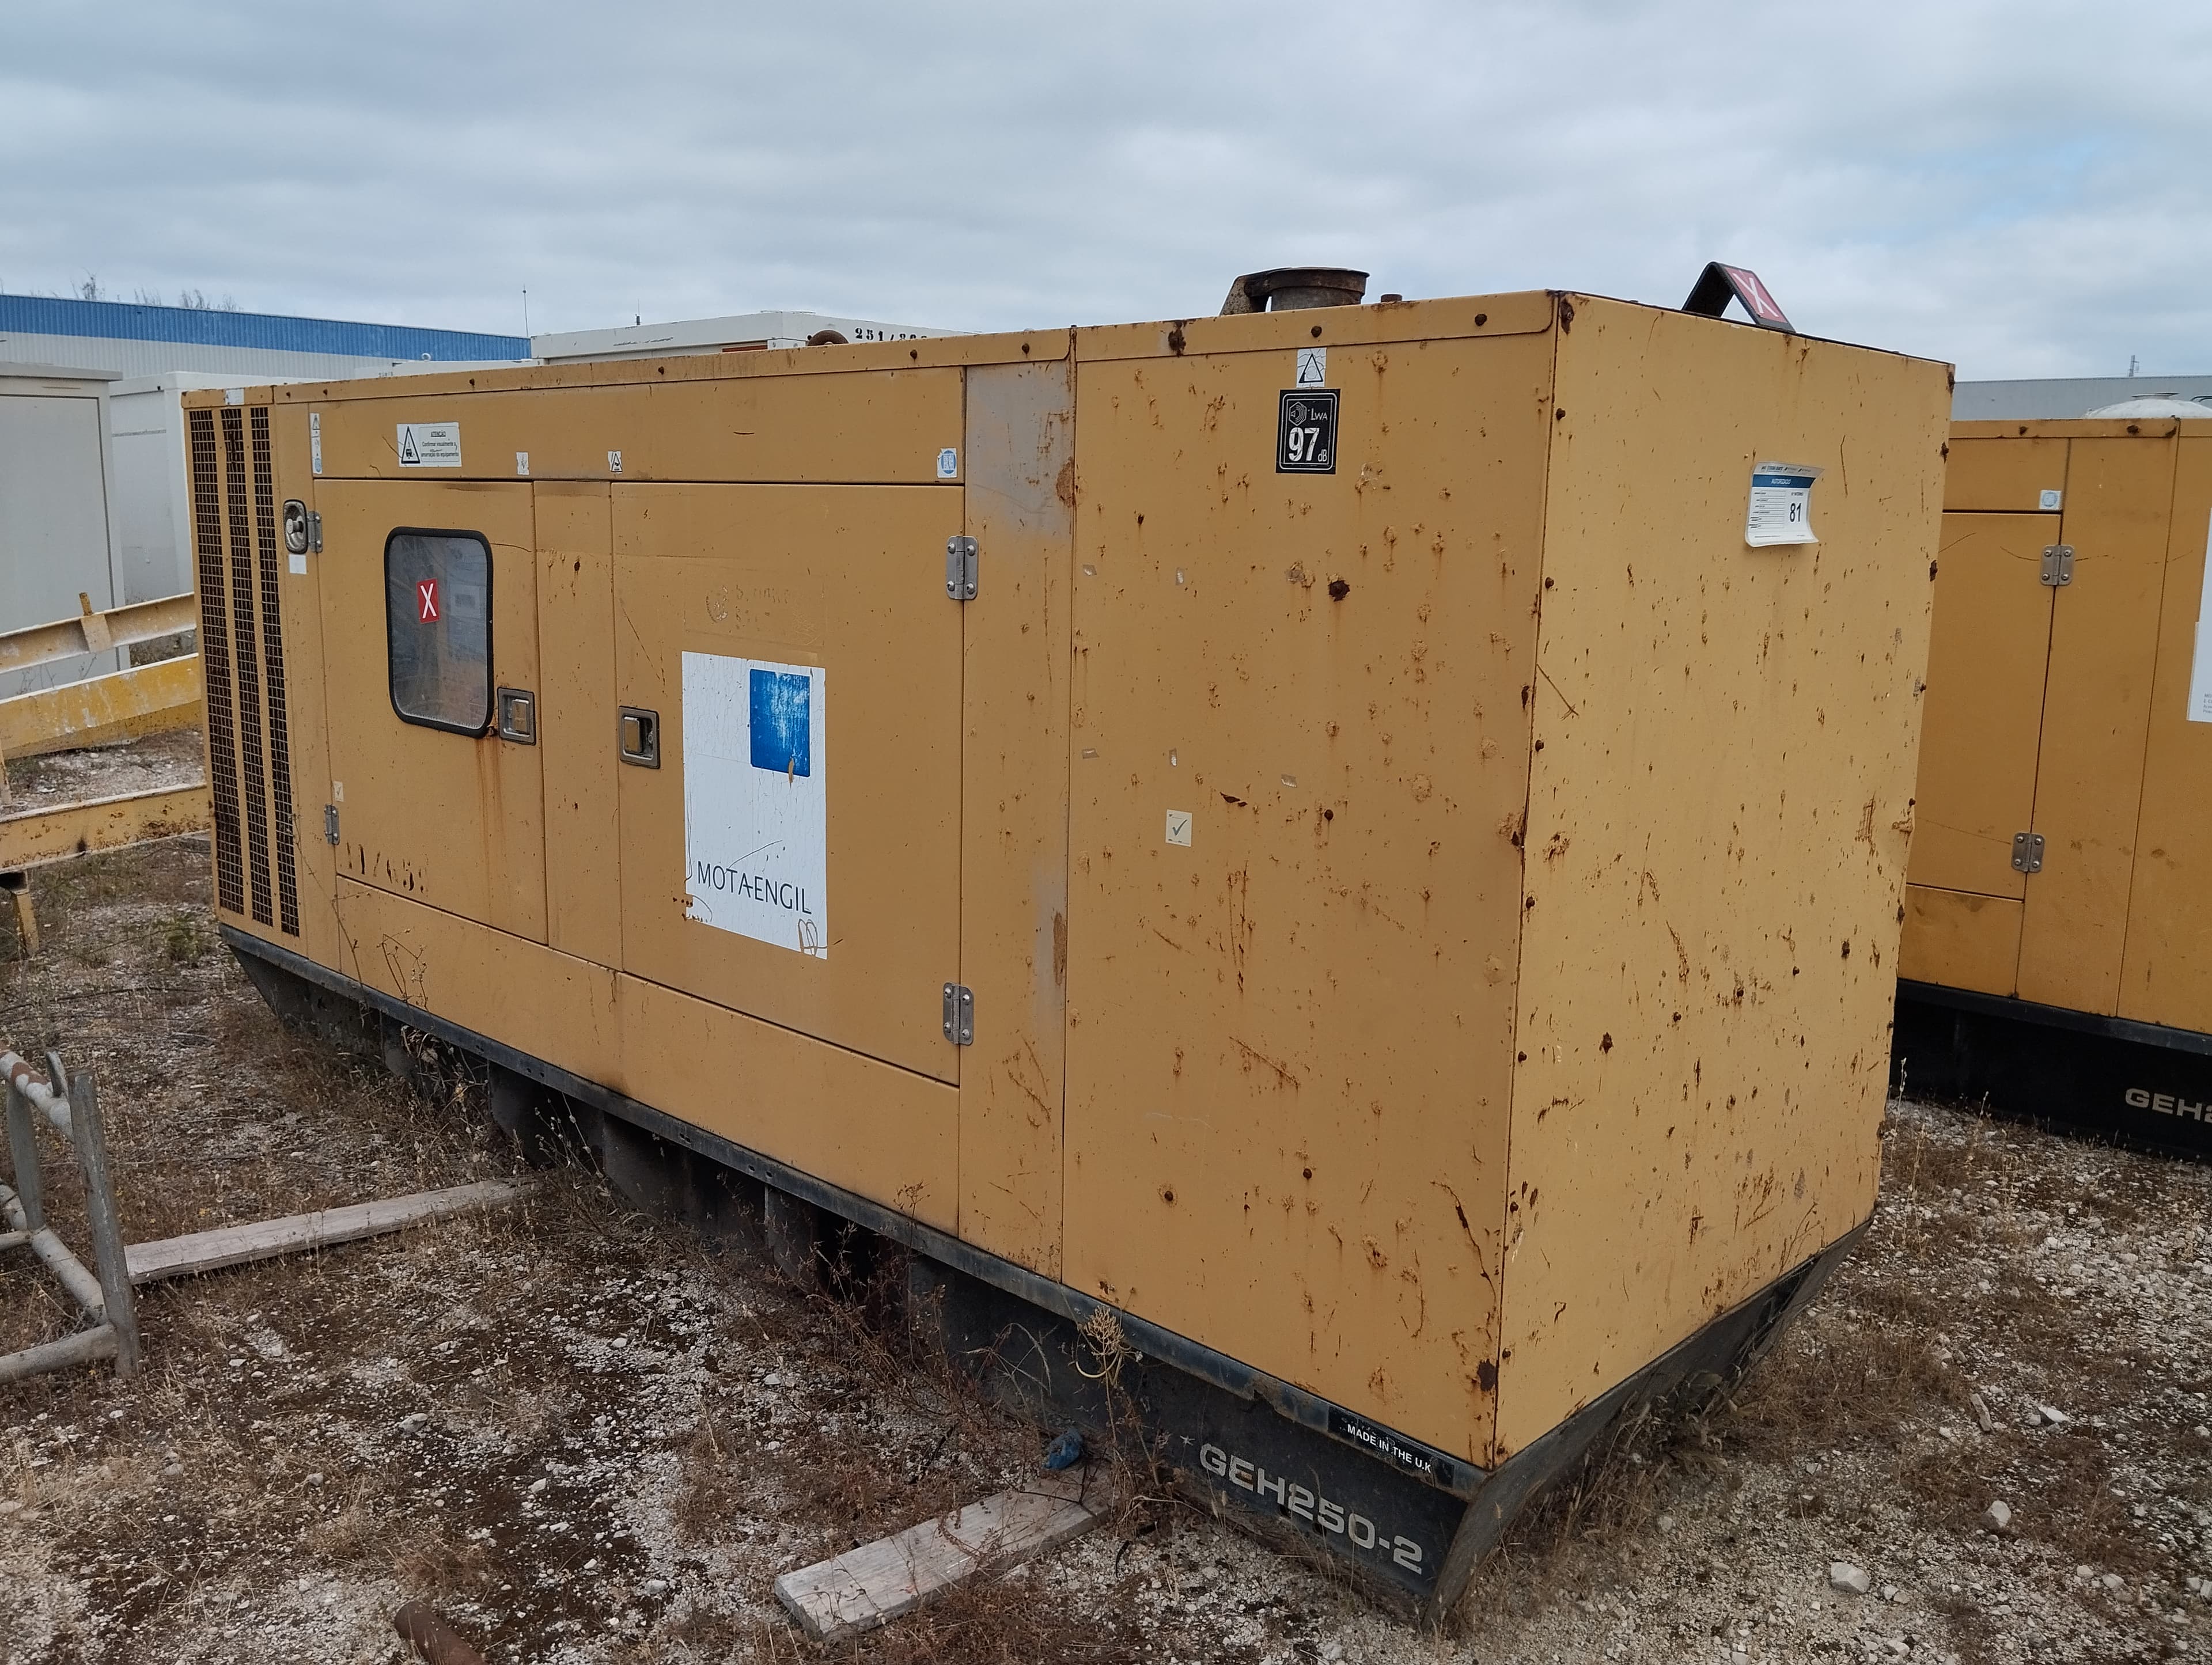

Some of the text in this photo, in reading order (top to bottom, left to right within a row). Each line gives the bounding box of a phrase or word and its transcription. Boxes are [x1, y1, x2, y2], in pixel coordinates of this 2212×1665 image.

[1288, 427, 1320, 462] 97
[1317, 449, 1327, 462] dB
[1789, 502, 1802, 522] 81
[1347, 1423, 1377, 1446] MADE
[1379, 1439, 1389, 1452] IN
[1393, 1446, 1412, 1463] THE
[1199, 1442, 1423, 1576] GEH250-2
